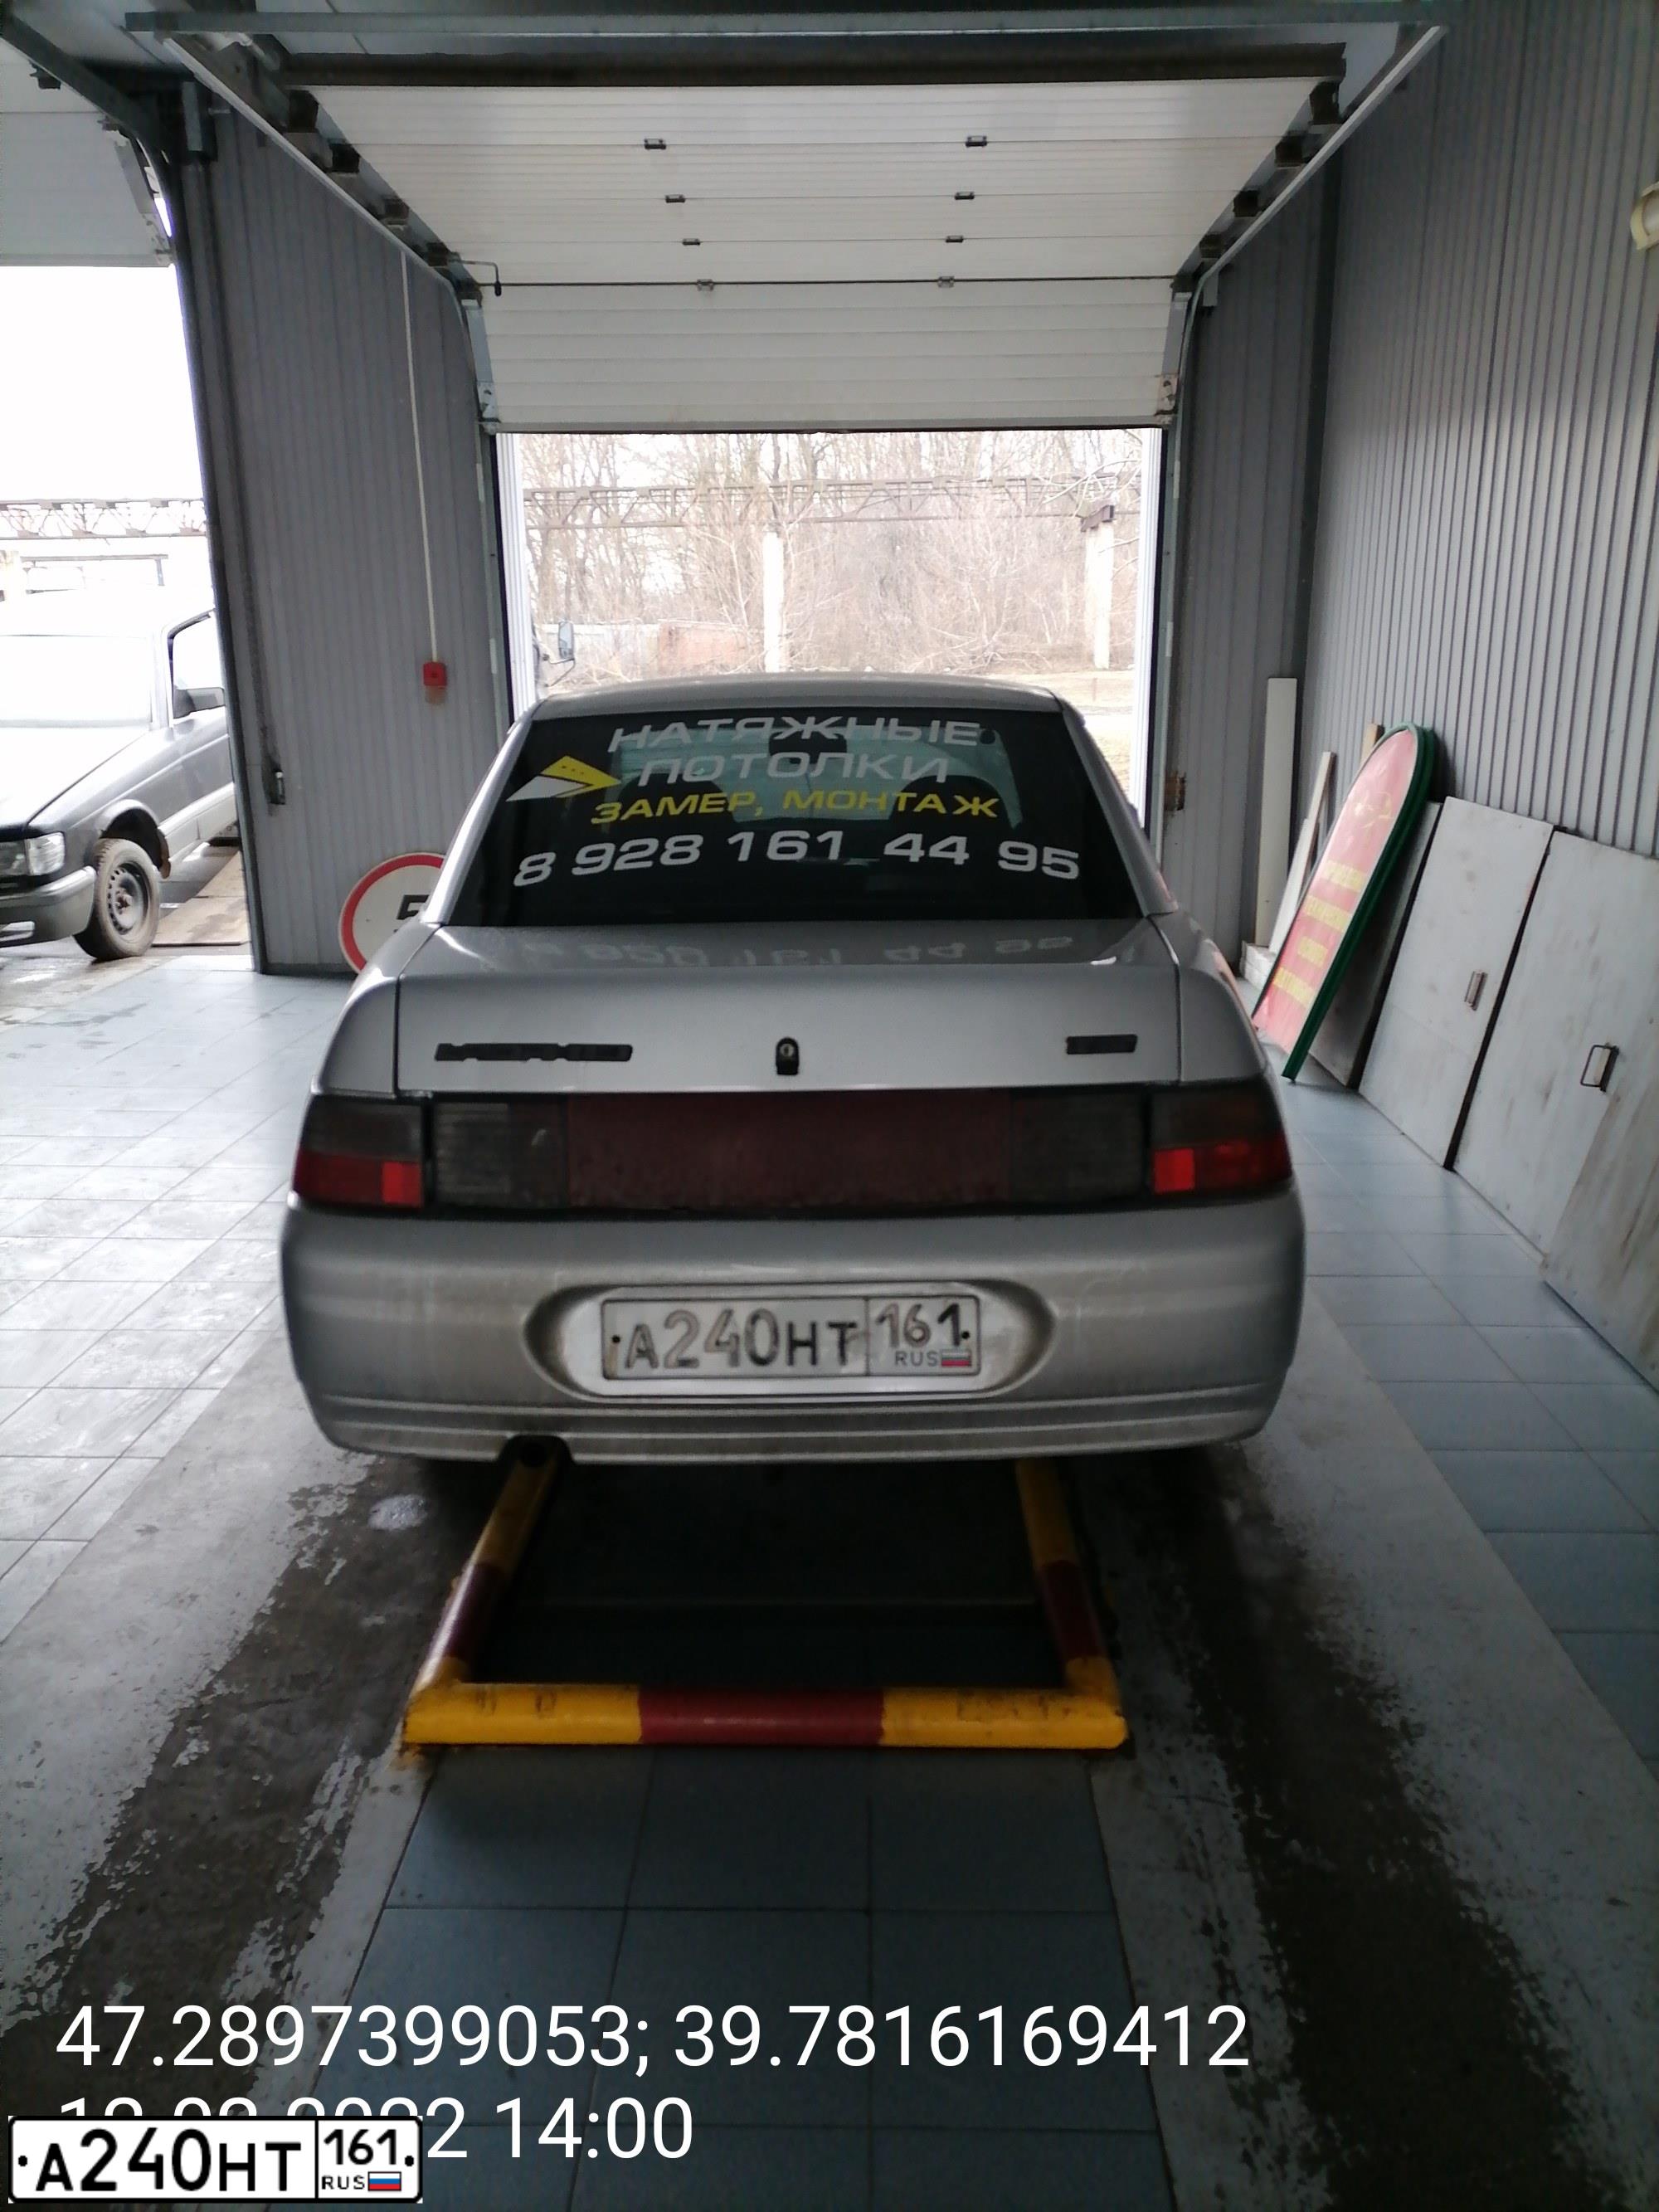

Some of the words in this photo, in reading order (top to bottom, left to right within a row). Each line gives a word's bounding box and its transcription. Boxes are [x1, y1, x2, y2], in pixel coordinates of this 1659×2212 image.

[607, 716, 980, 753] НАТЯЖНЫЕ
[638, 752, 949, 787] ПОТОЛКИ
[590, 791, 763, 824] ЗАМЕР,
[783, 790, 1000, 818] МОНТАЖ
[513, 843, 557, 887] 8
[572, 834, 704, 875] 928
[727, 831, 844, 862] 161
[883, 832, 970, 865] 44
[997, 840, 1079, 879] 95
[625, 1308, 858, 1369] А240НТ
[875, 1303, 962, 1348] 161
[894, 1352, 939, 1367] RUS
